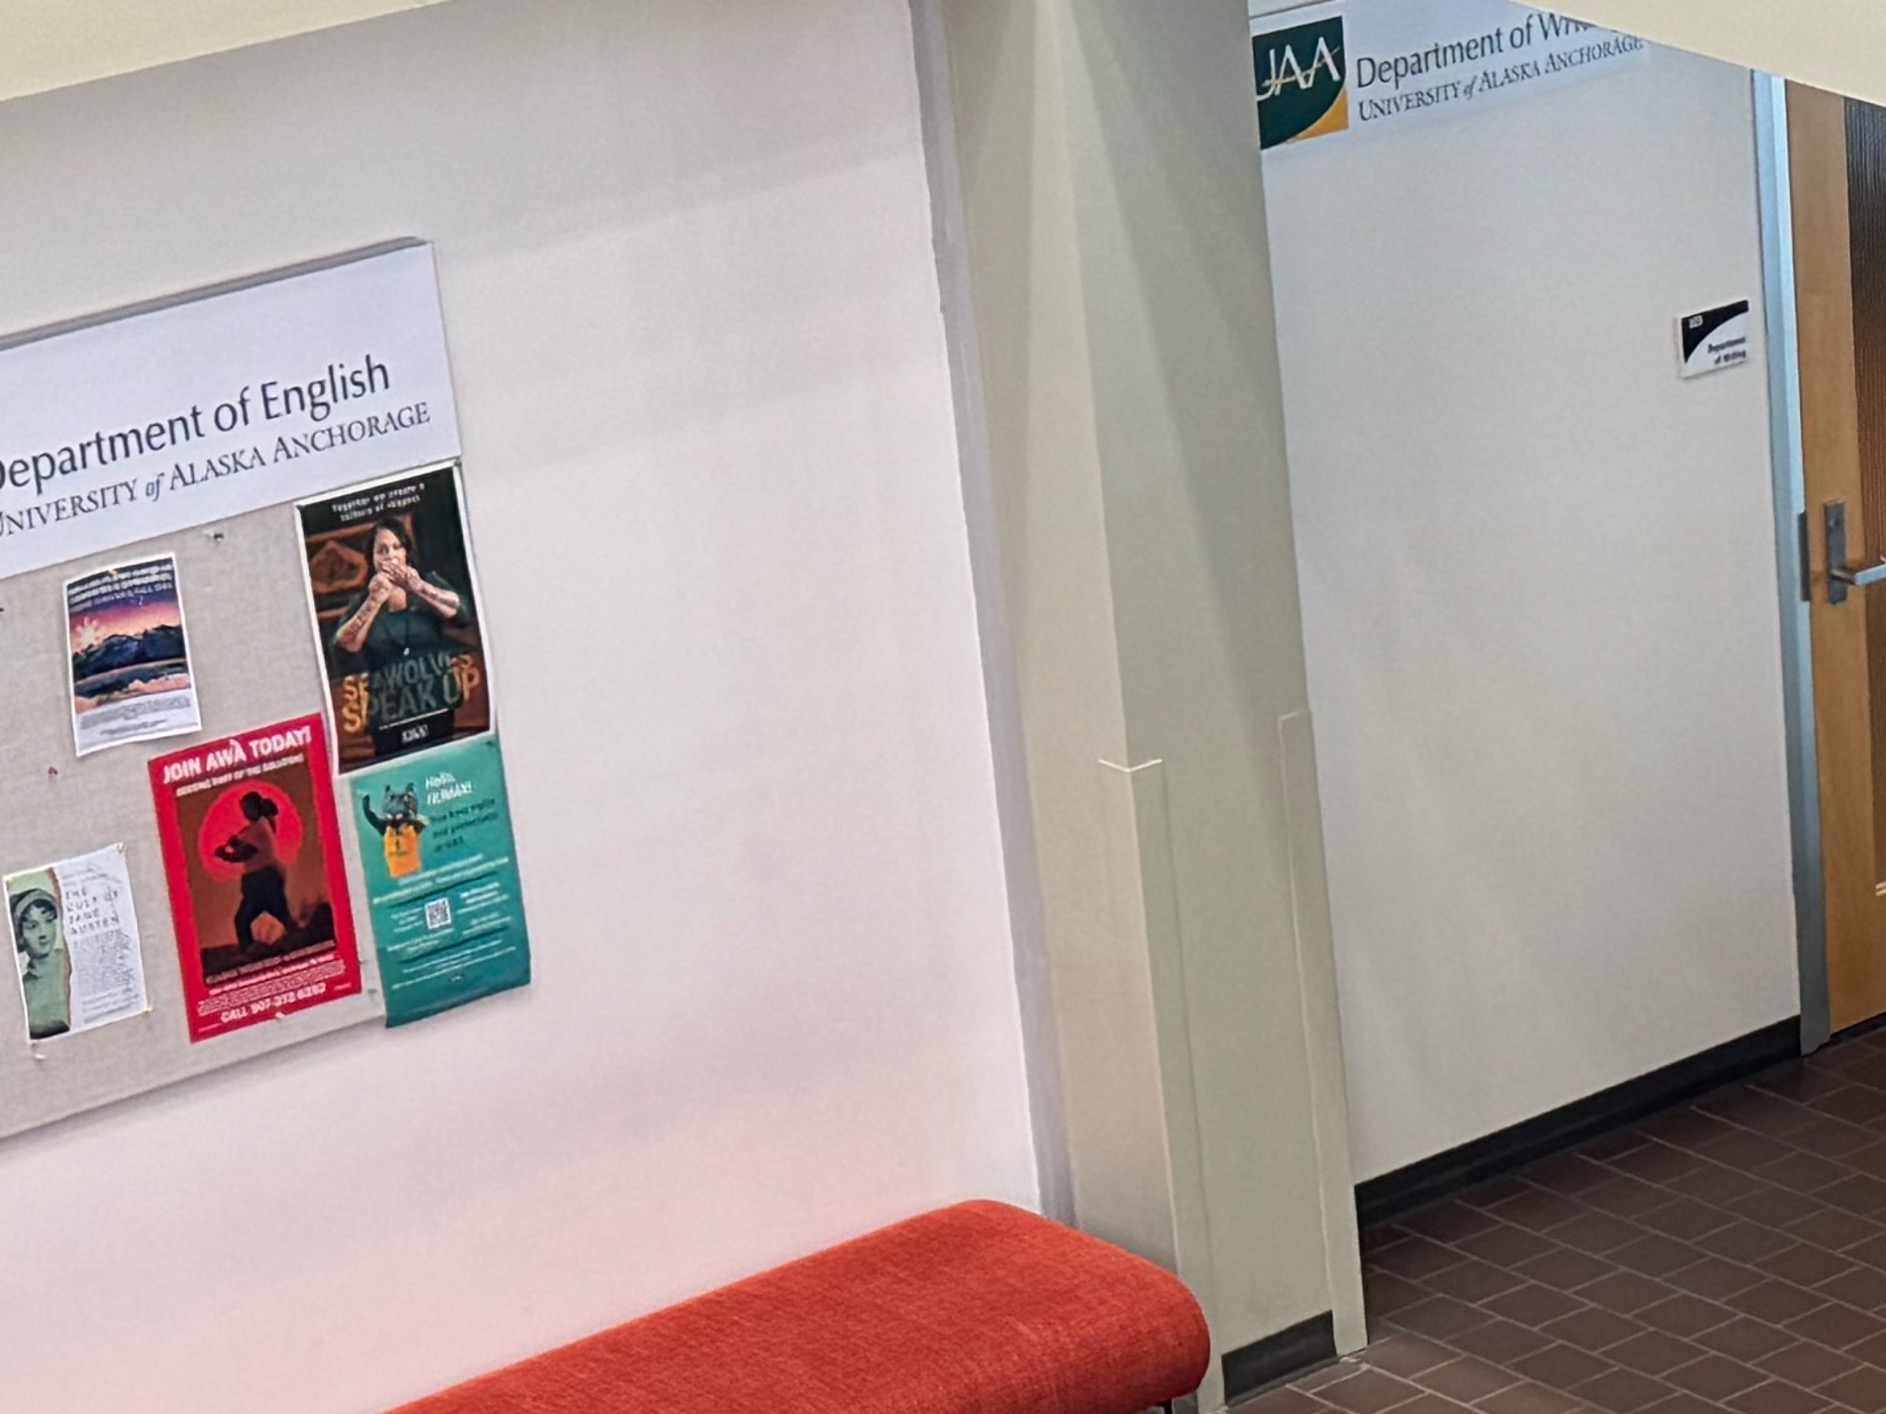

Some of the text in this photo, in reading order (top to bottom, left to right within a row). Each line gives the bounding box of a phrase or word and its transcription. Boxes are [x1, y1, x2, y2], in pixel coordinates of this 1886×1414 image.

[1356, 25, 1504, 90] Department
[1510, 13, 1534, 48] of
[1358, 81, 1464, 121] UNIVERSITY
[1464, 74, 1479, 100] of
[1478, 62, 1541, 93] ALASKA
[0, 353, 391, 495] epartment of English
[146, 473, 165, 502] of
[169, 447, 267, 491] ALASKA
[273, 402, 432, 463] ANCHORAGE
[163, 759, 202, 784] JOIN
[248, 725, 312, 759] TODAY!
